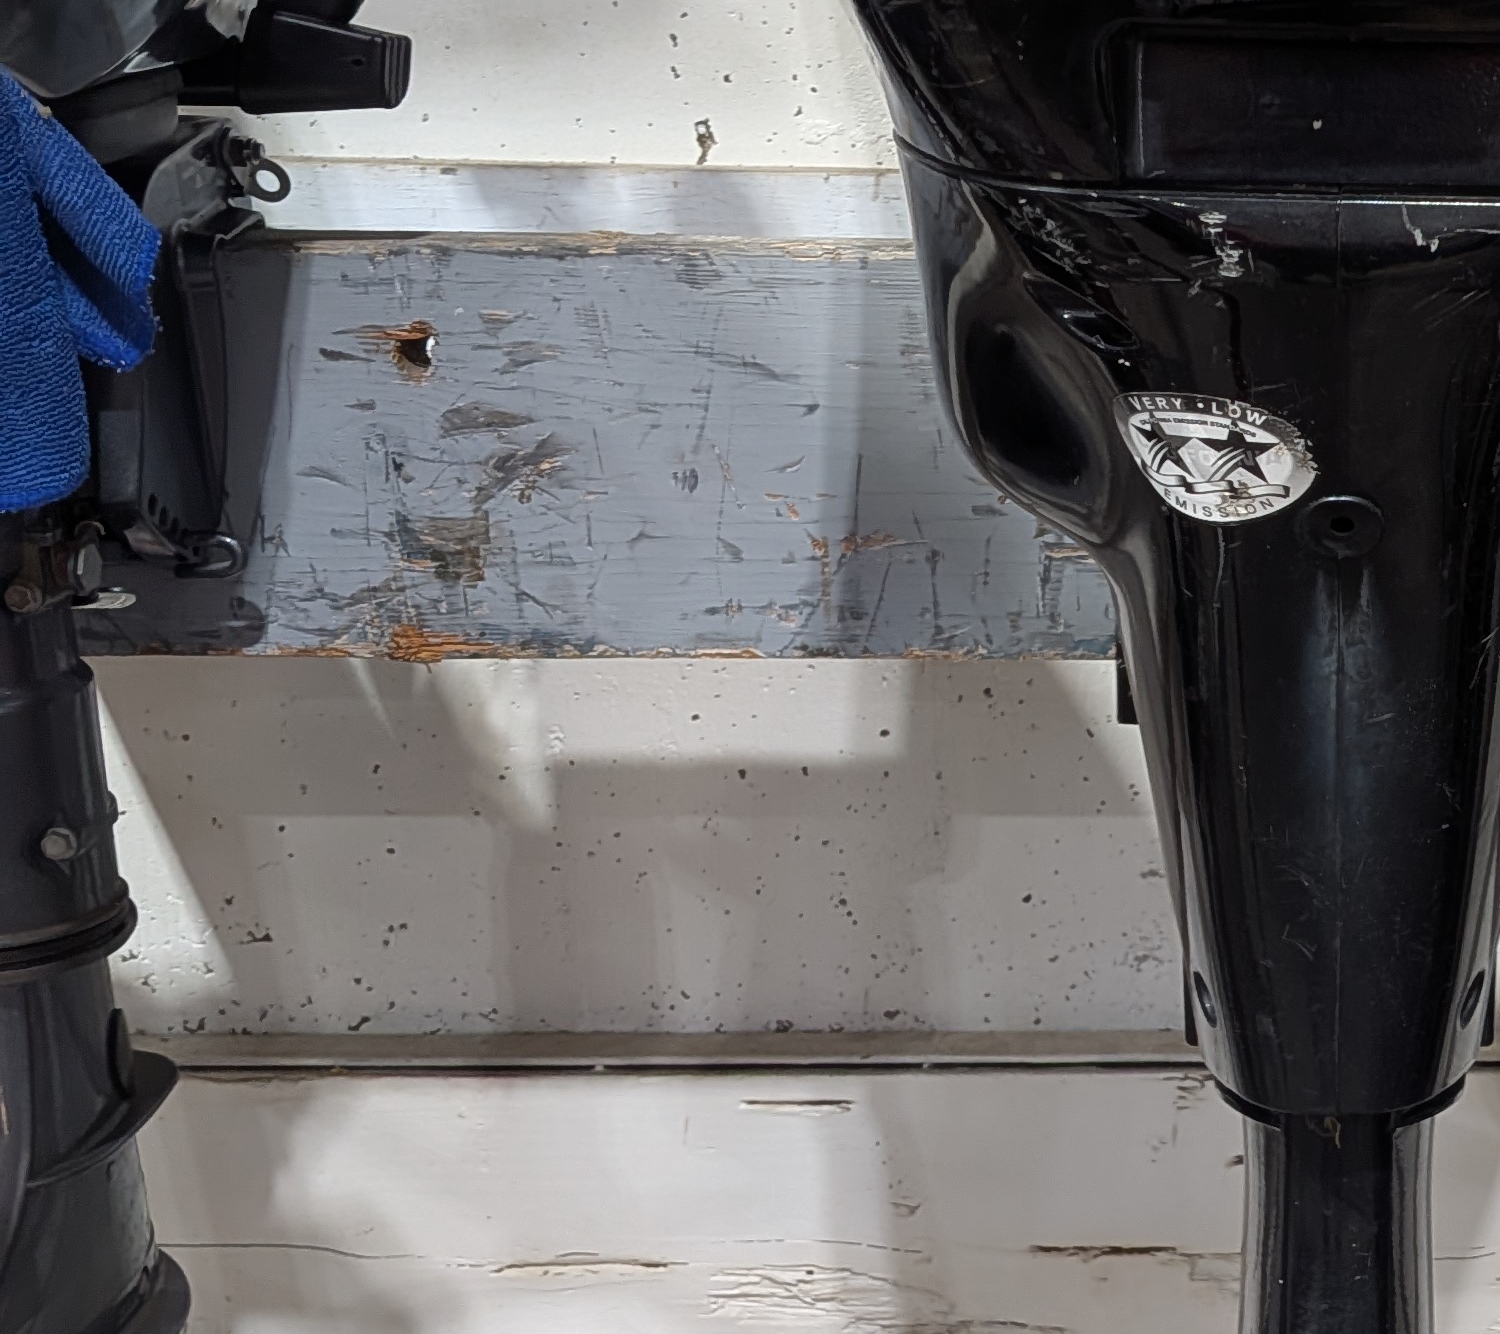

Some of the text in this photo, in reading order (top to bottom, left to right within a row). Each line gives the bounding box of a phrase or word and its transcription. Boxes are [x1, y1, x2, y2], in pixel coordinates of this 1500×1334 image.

[1127, 396, 1268, 426] VERY LOW
[1163, 487, 1275, 518] EMISSION
